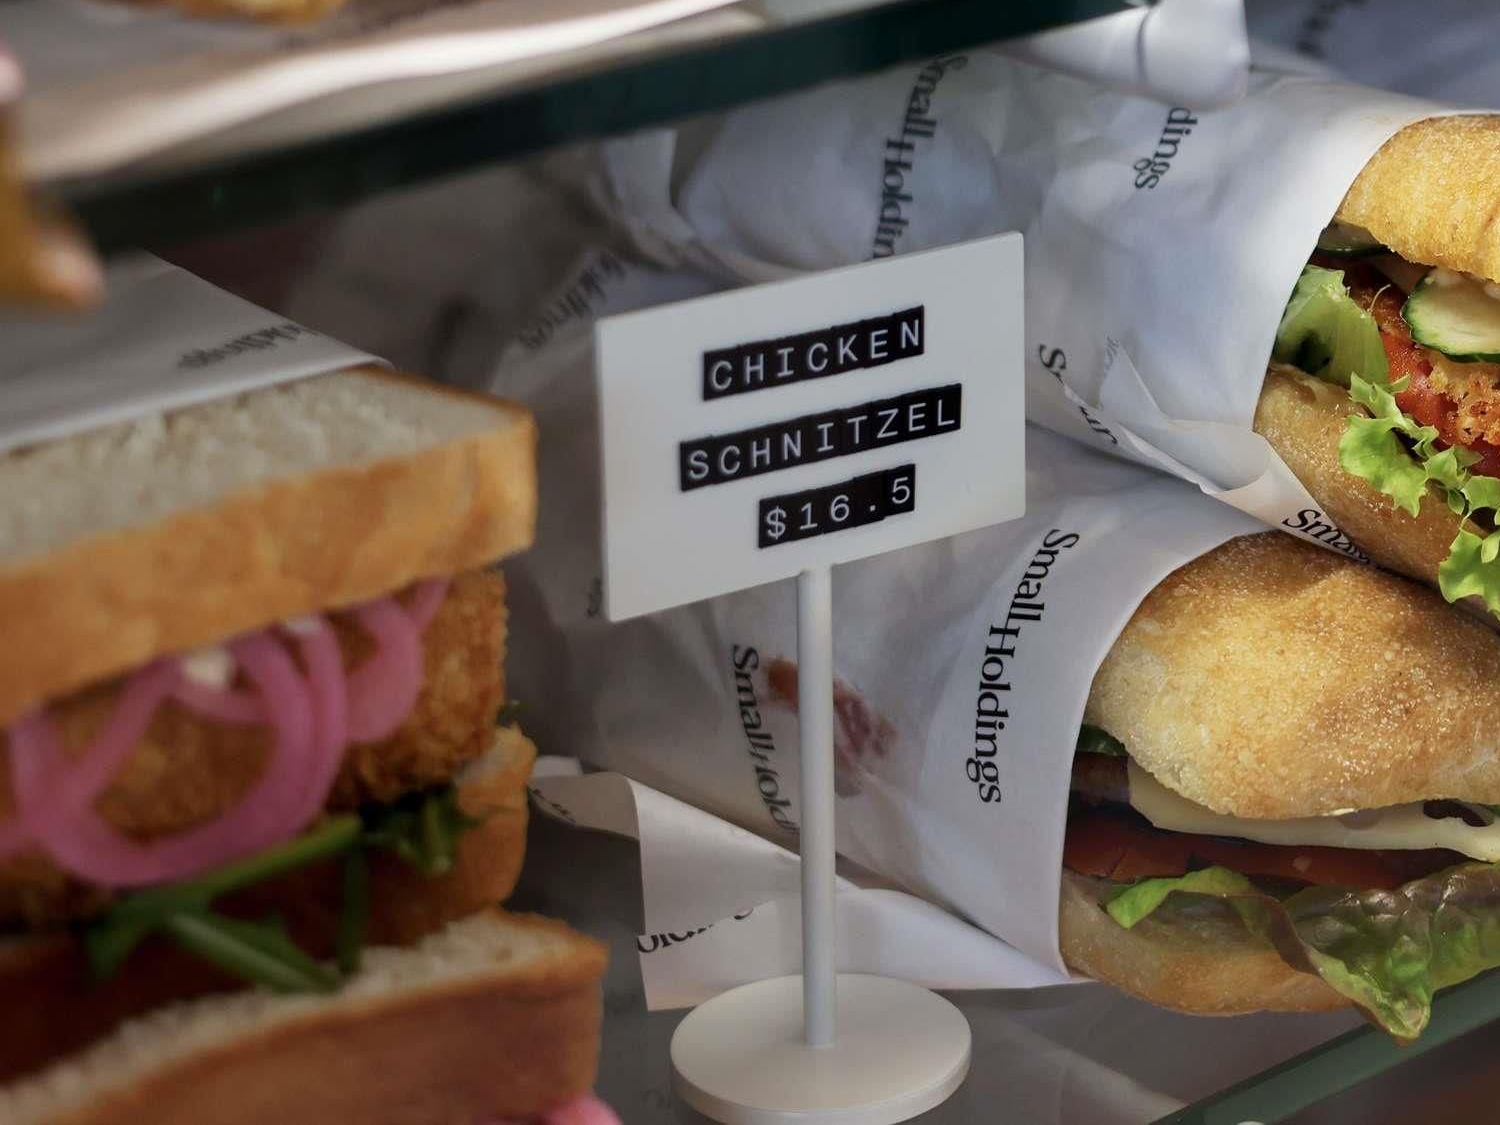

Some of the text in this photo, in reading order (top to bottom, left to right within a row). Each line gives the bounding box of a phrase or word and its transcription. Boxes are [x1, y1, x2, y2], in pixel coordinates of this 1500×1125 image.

[1132, 106, 1198, 190] dings
[872, 137, 916, 260] Holdin
[710, 317, 921, 392] CHICKEN
[688, 398, 956, 481] SCHNITZEL
[764, 475, 912, 541] $16.5
